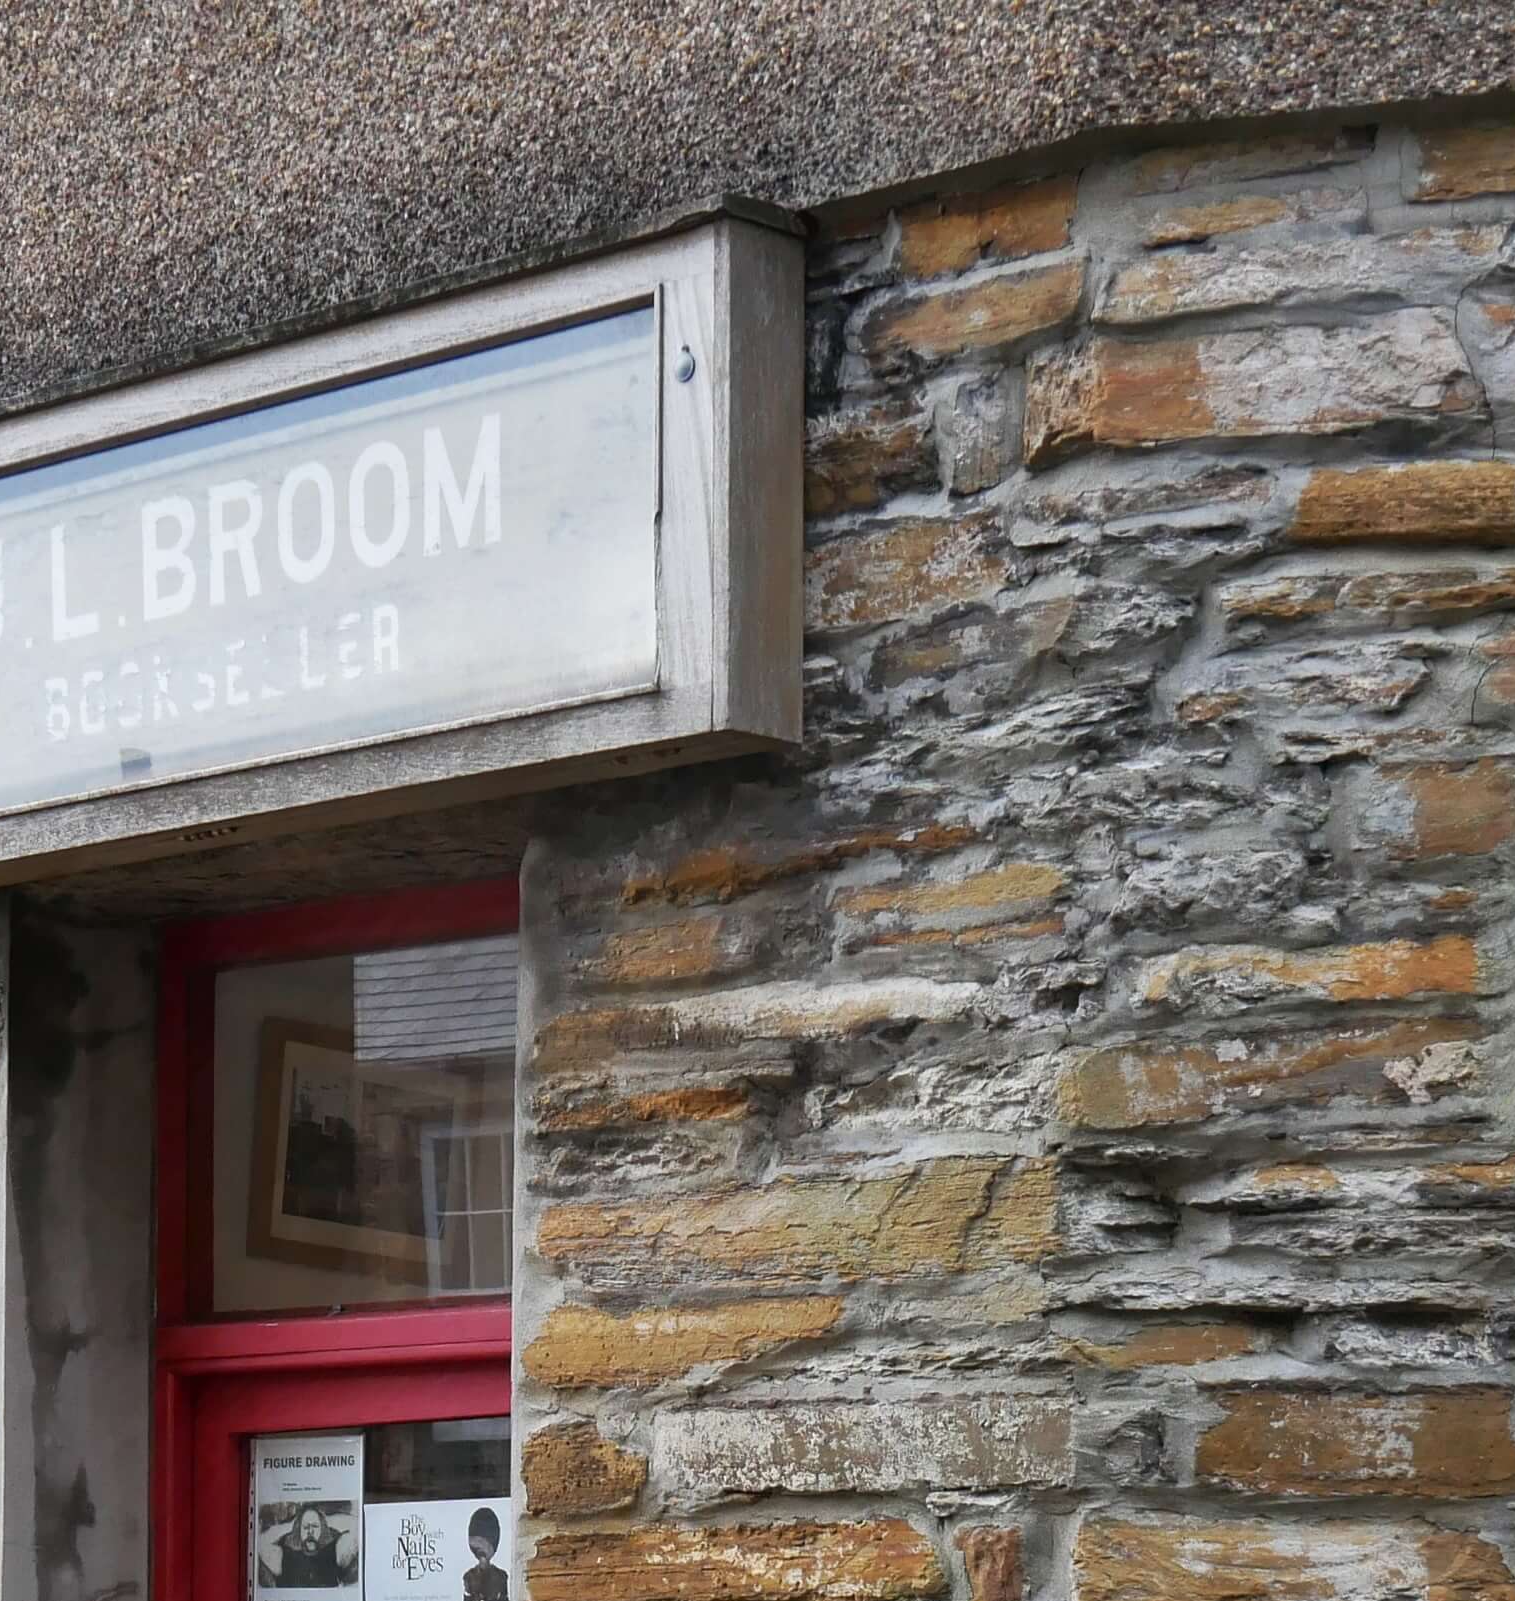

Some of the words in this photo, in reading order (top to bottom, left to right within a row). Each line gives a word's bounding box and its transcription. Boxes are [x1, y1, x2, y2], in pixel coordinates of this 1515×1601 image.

[141, 412, 501, 622] BROOM
[263, 1457, 303, 1469] FIGURE
[305, 1455, 356, 1468] DRAWING
[400, 1518, 427, 1537] Boy
[397, 1534, 437, 1559] Nails
[392, 1554, 408, 1569] for
[406, 1555, 444, 1581] Eyes
